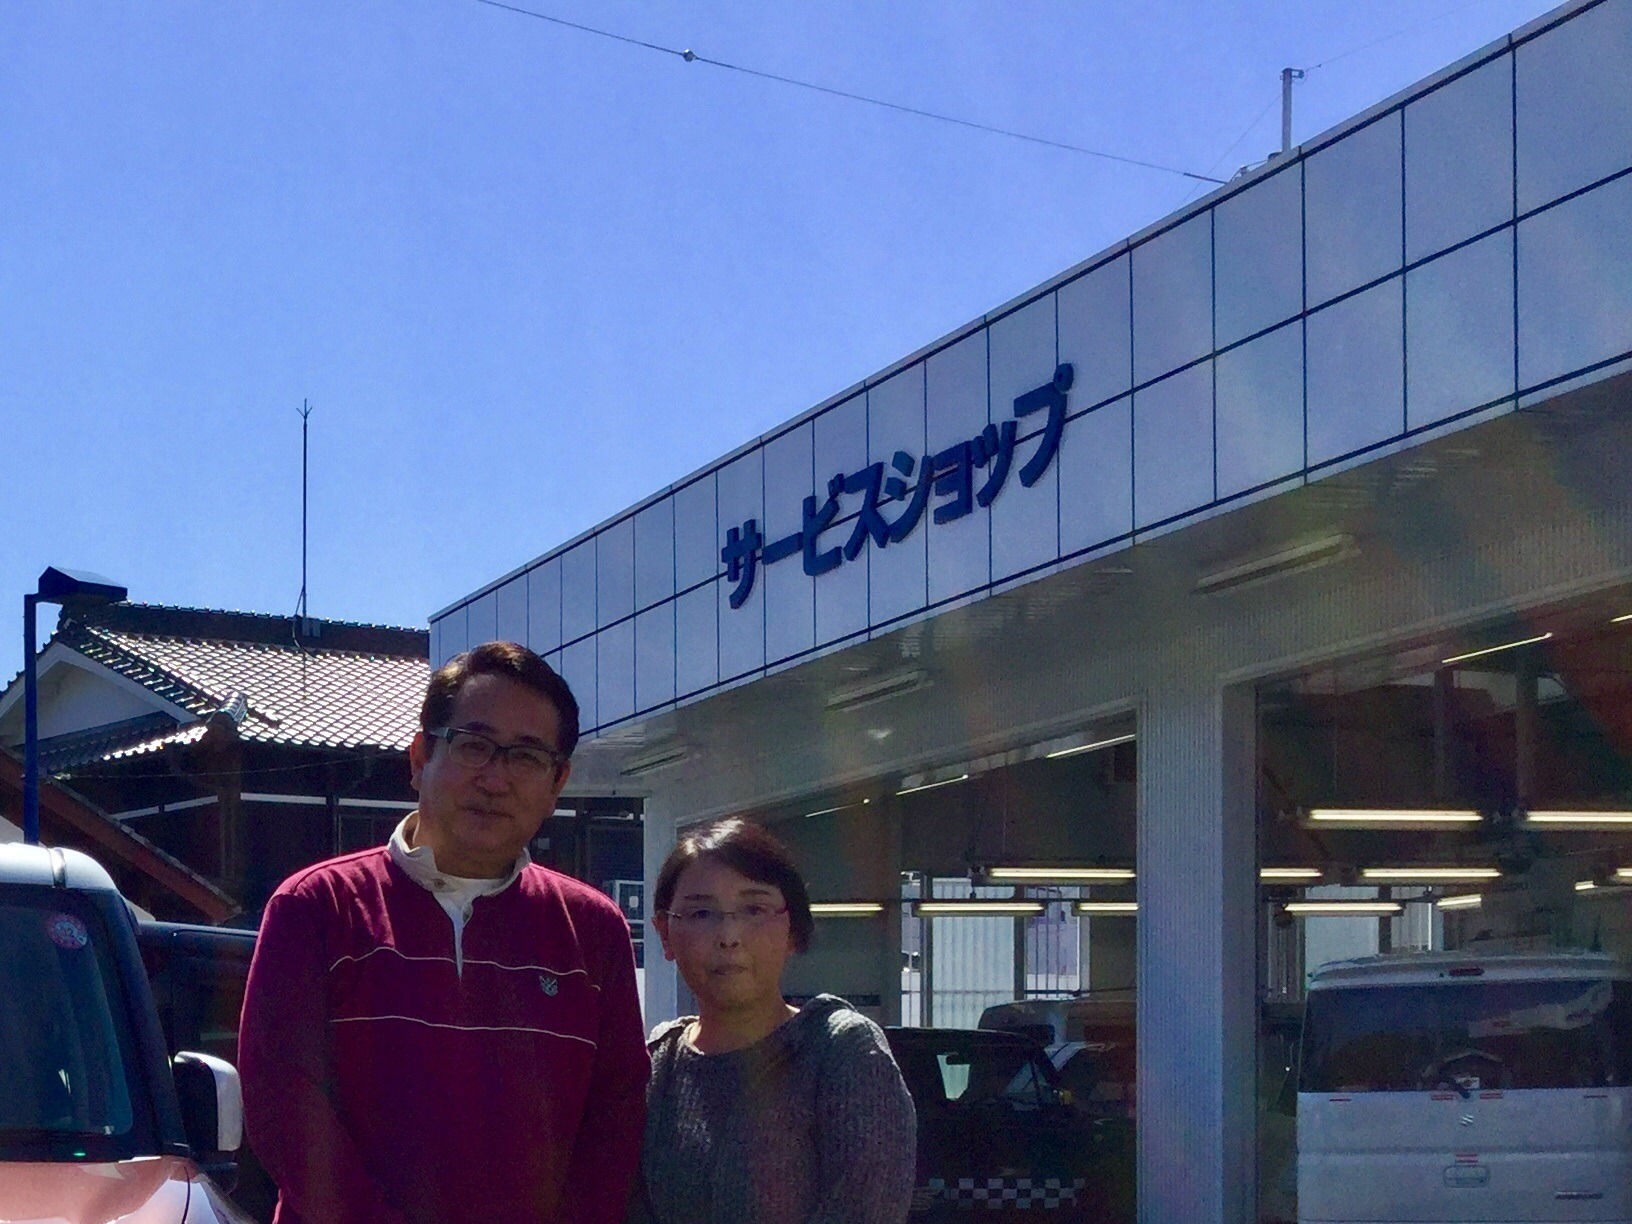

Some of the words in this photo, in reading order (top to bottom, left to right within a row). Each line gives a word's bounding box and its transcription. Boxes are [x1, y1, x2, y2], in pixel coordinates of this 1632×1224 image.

[721, 362, 1074, 609] サービスショップ
